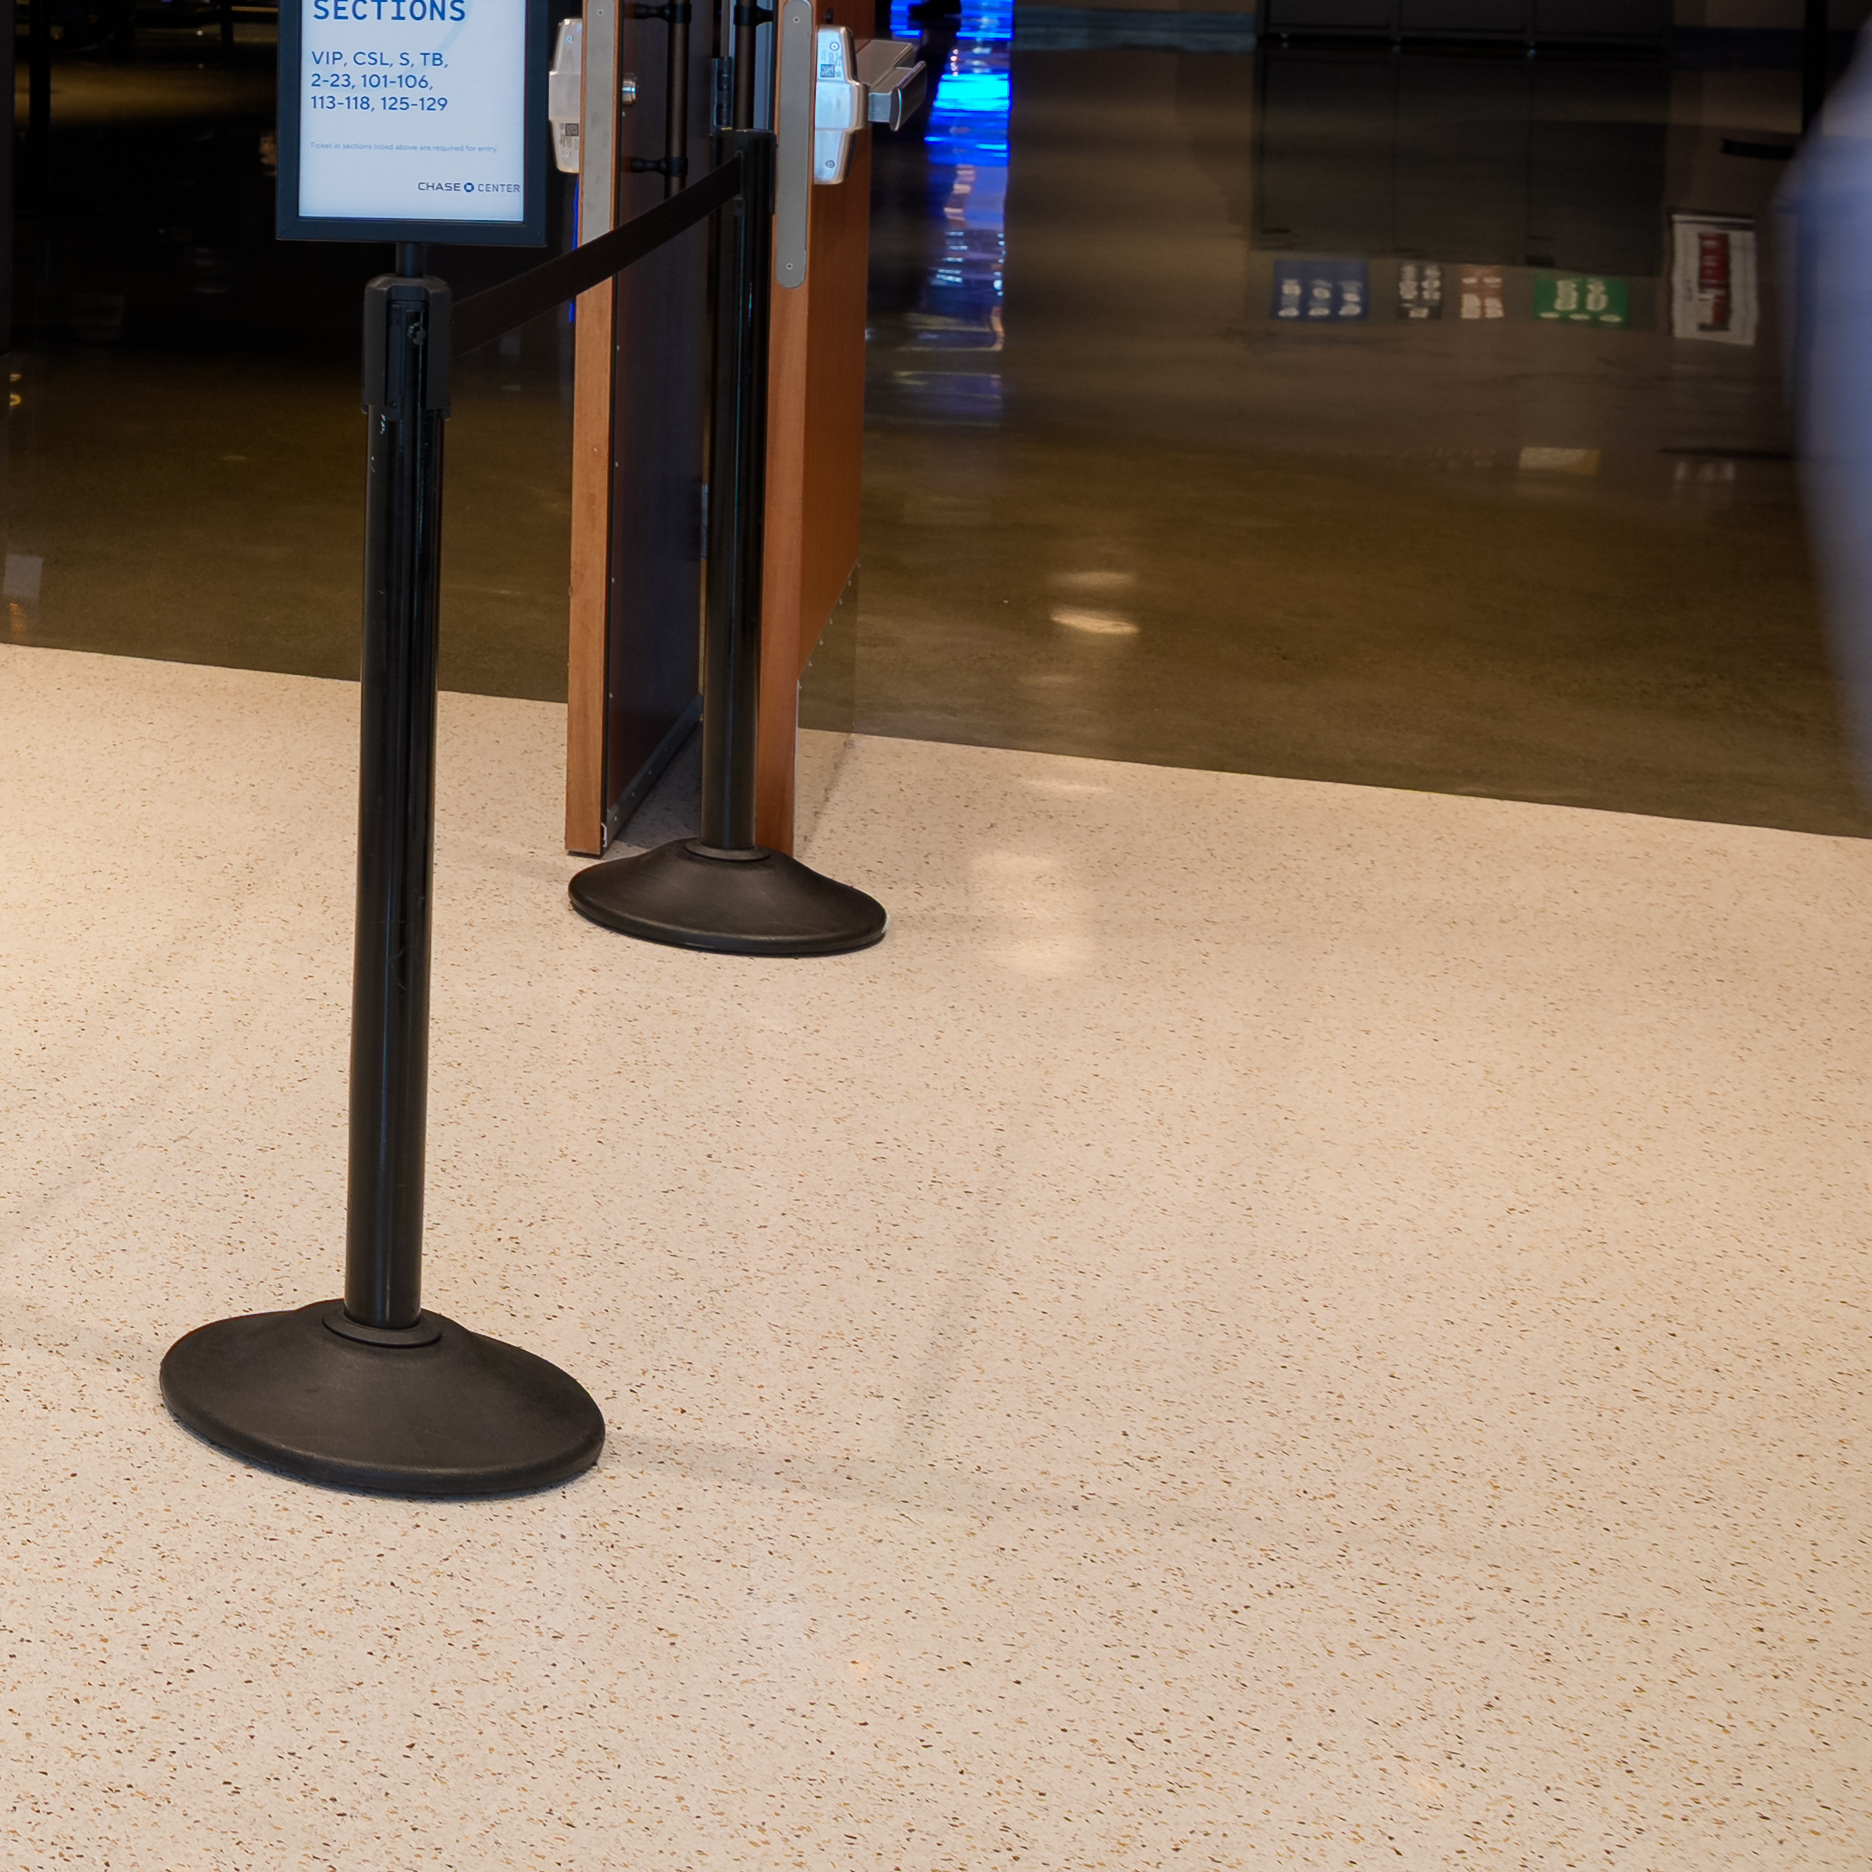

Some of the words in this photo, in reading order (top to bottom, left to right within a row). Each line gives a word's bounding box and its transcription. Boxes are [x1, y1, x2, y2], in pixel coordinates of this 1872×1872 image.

[311, 50, 348, 68] VIP,
[352, 50, 393, 68] CSL,
[398, 51, 415, 69] S,
[419, 51, 449, 69] TB,
[310, 72, 356, 90] 2-23,
[360, 73, 434, 91] 101-106,
[310, 95, 375, 113] 113-118,
[380, 96, 449, 112] 125-129
[310, 141, 332, 149] Ticket
[342, 142, 373, 150] sections
[395, 143, 418, 151] above
[433, 144, 464, 152] required
[417, 181, 462, 192] CHASE
[477, 183, 521, 193] CENTER
